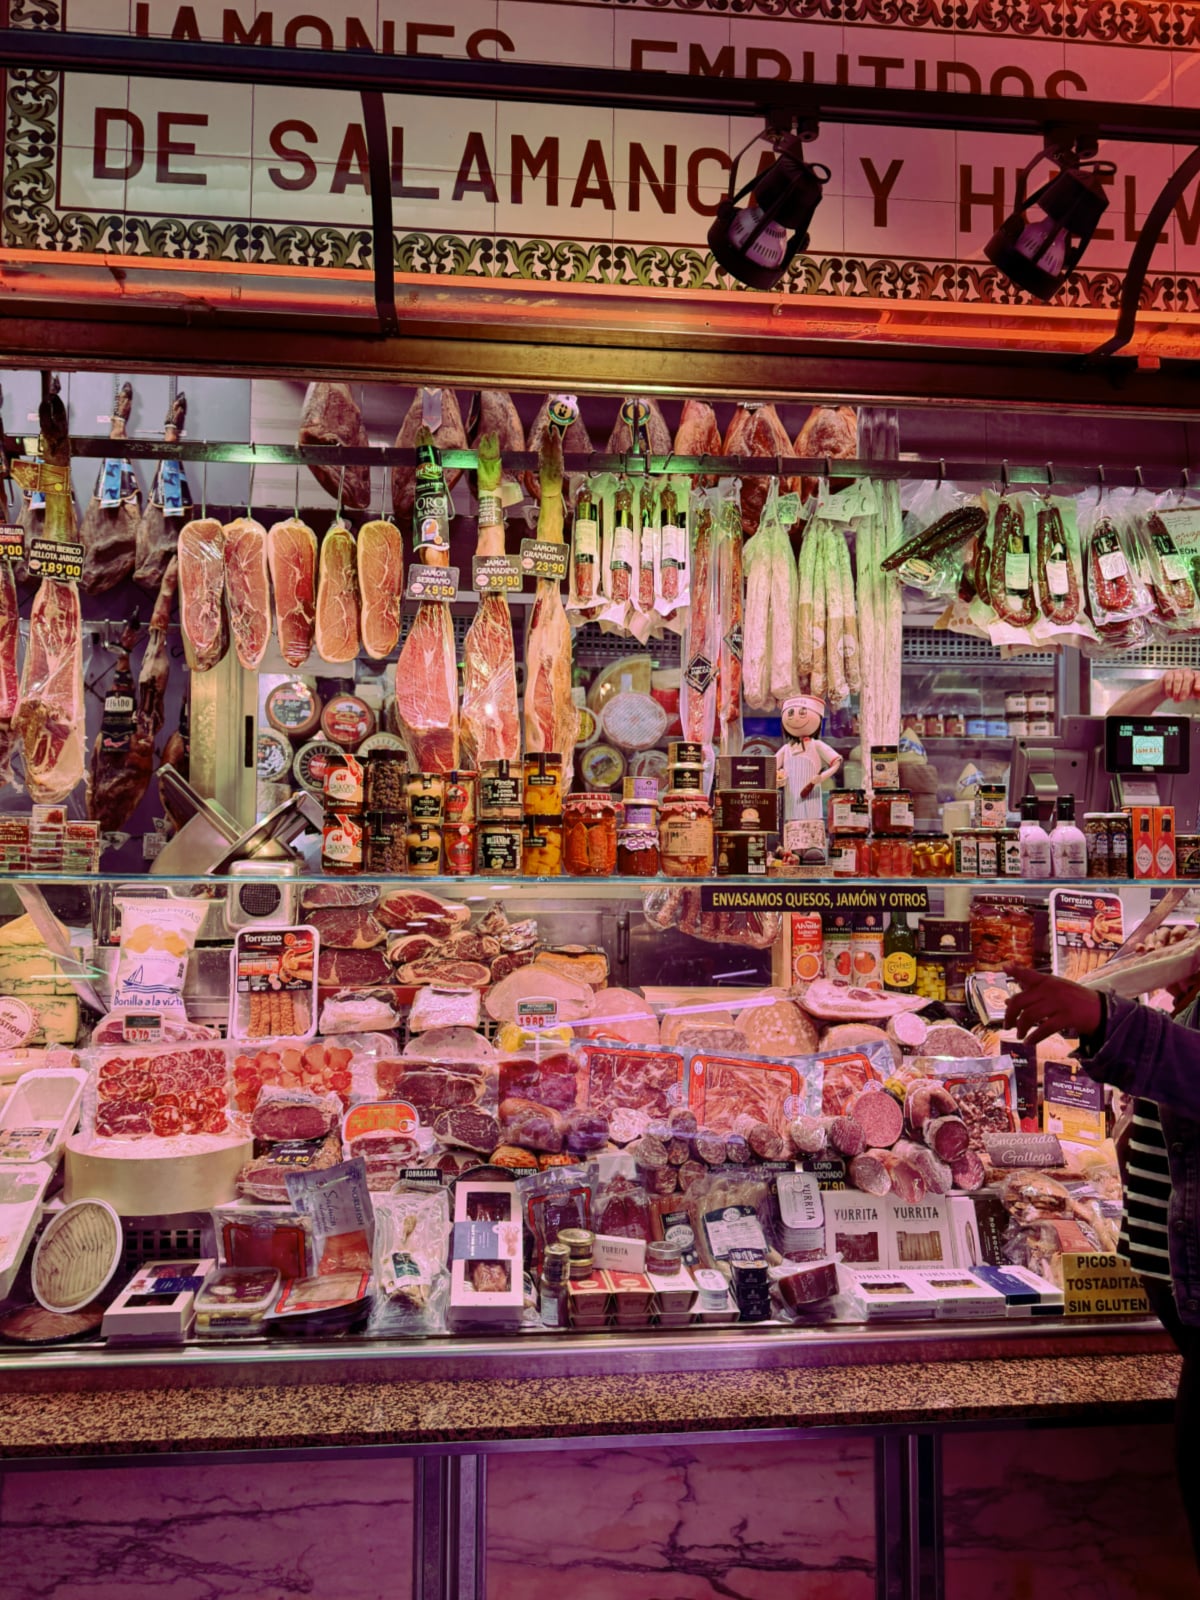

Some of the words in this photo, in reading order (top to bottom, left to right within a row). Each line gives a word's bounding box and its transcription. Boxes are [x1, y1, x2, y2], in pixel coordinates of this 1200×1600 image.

[93, 107, 208, 185] DE
[859, 157, 904, 228] Y
[415, 497, 446, 510] ORO
[31, 550, 57, 560] BELLOTA
[523, 551, 565, 562] GRANADINO
[40, 561, 81, 576] 189'00
[476, 567, 519, 575] GRANADINO
[535, 562, 565, 574] 23'90
[416, 576, 451, 586] SERRANO
[490, 576, 520, 586] 39'90
[424, 585, 456, 596] 49'50
[712, 892, 783, 907] ENVASAMOS
[785, 891, 834, 908] QUESOS,
[836, 889, 877, 907] JAMÓN
[878, 892, 888, 907] Y
[889, 892, 927, 907] OTROS
[1059, 894, 1093, 905] Torrezno
[243, 934, 282, 943] Torrezno
[114, 989, 143, 1006] Bonilla
[144, 998, 150, 1006] a
[151, 994, 161, 1006] la
[1051, 1081, 1072, 1090] HUEVO
[986, 1134, 1057, 1148] Empanada
[1001, 1149, 1054, 1165] Gallega
[812, 1162, 832, 1170] LOMO
[802, 1183, 817, 1221] YURRITA
[834, 1208, 879, 1221] YURRITA
[893, 1206, 939, 1219] YURRITA
[601, 1245, 629, 1256] YURRITA
[1077, 1255, 1117, 1268] PICOS
[1068, 1300, 1091, 1313] SIN
[1095, 1297, 1148, 1312] GLUTEN
